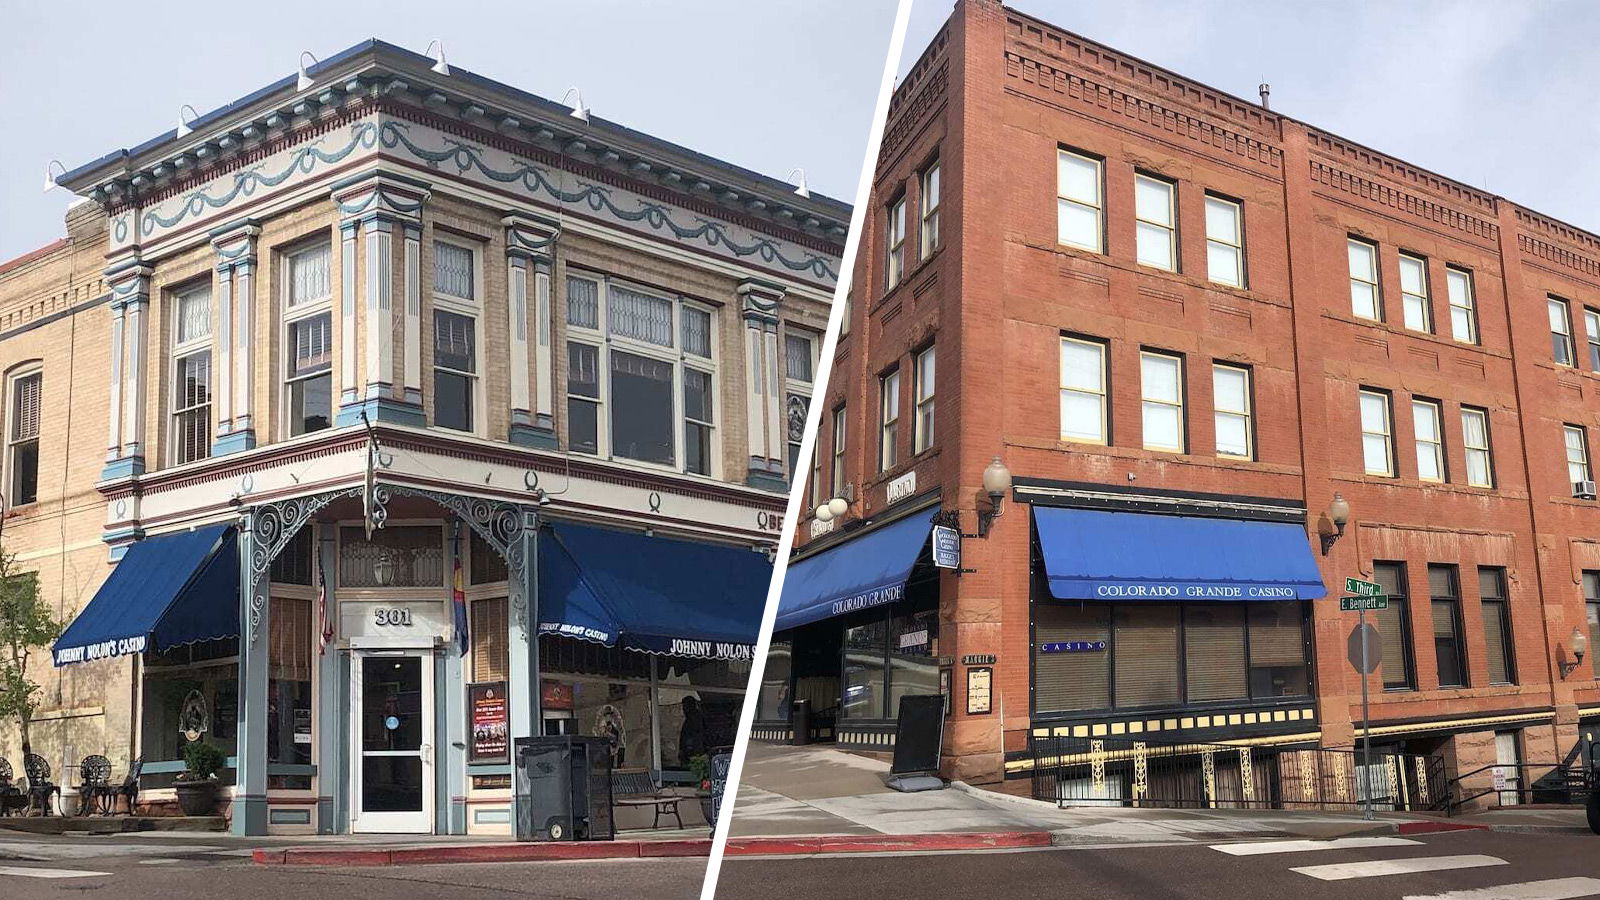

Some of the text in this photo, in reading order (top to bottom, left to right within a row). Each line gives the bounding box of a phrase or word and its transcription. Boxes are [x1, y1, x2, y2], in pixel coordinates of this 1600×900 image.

[1098, 586, 1294, 597] COLORADO GRANDE CASINO
[1356, 581, 1374, 596] Third
[832, 585, 902, 615] COLORADO GRANDE
[1350, 597, 1376, 608] Bennett
[375, 607, 411, 625] 301
[585, 628, 608, 641] CASINO
[57, 636, 145, 664] JOHNNY NOLON'S CASINO
[670, 639, 712, 656] JOHNNY
[1041, 641, 1106, 651] CASINO
